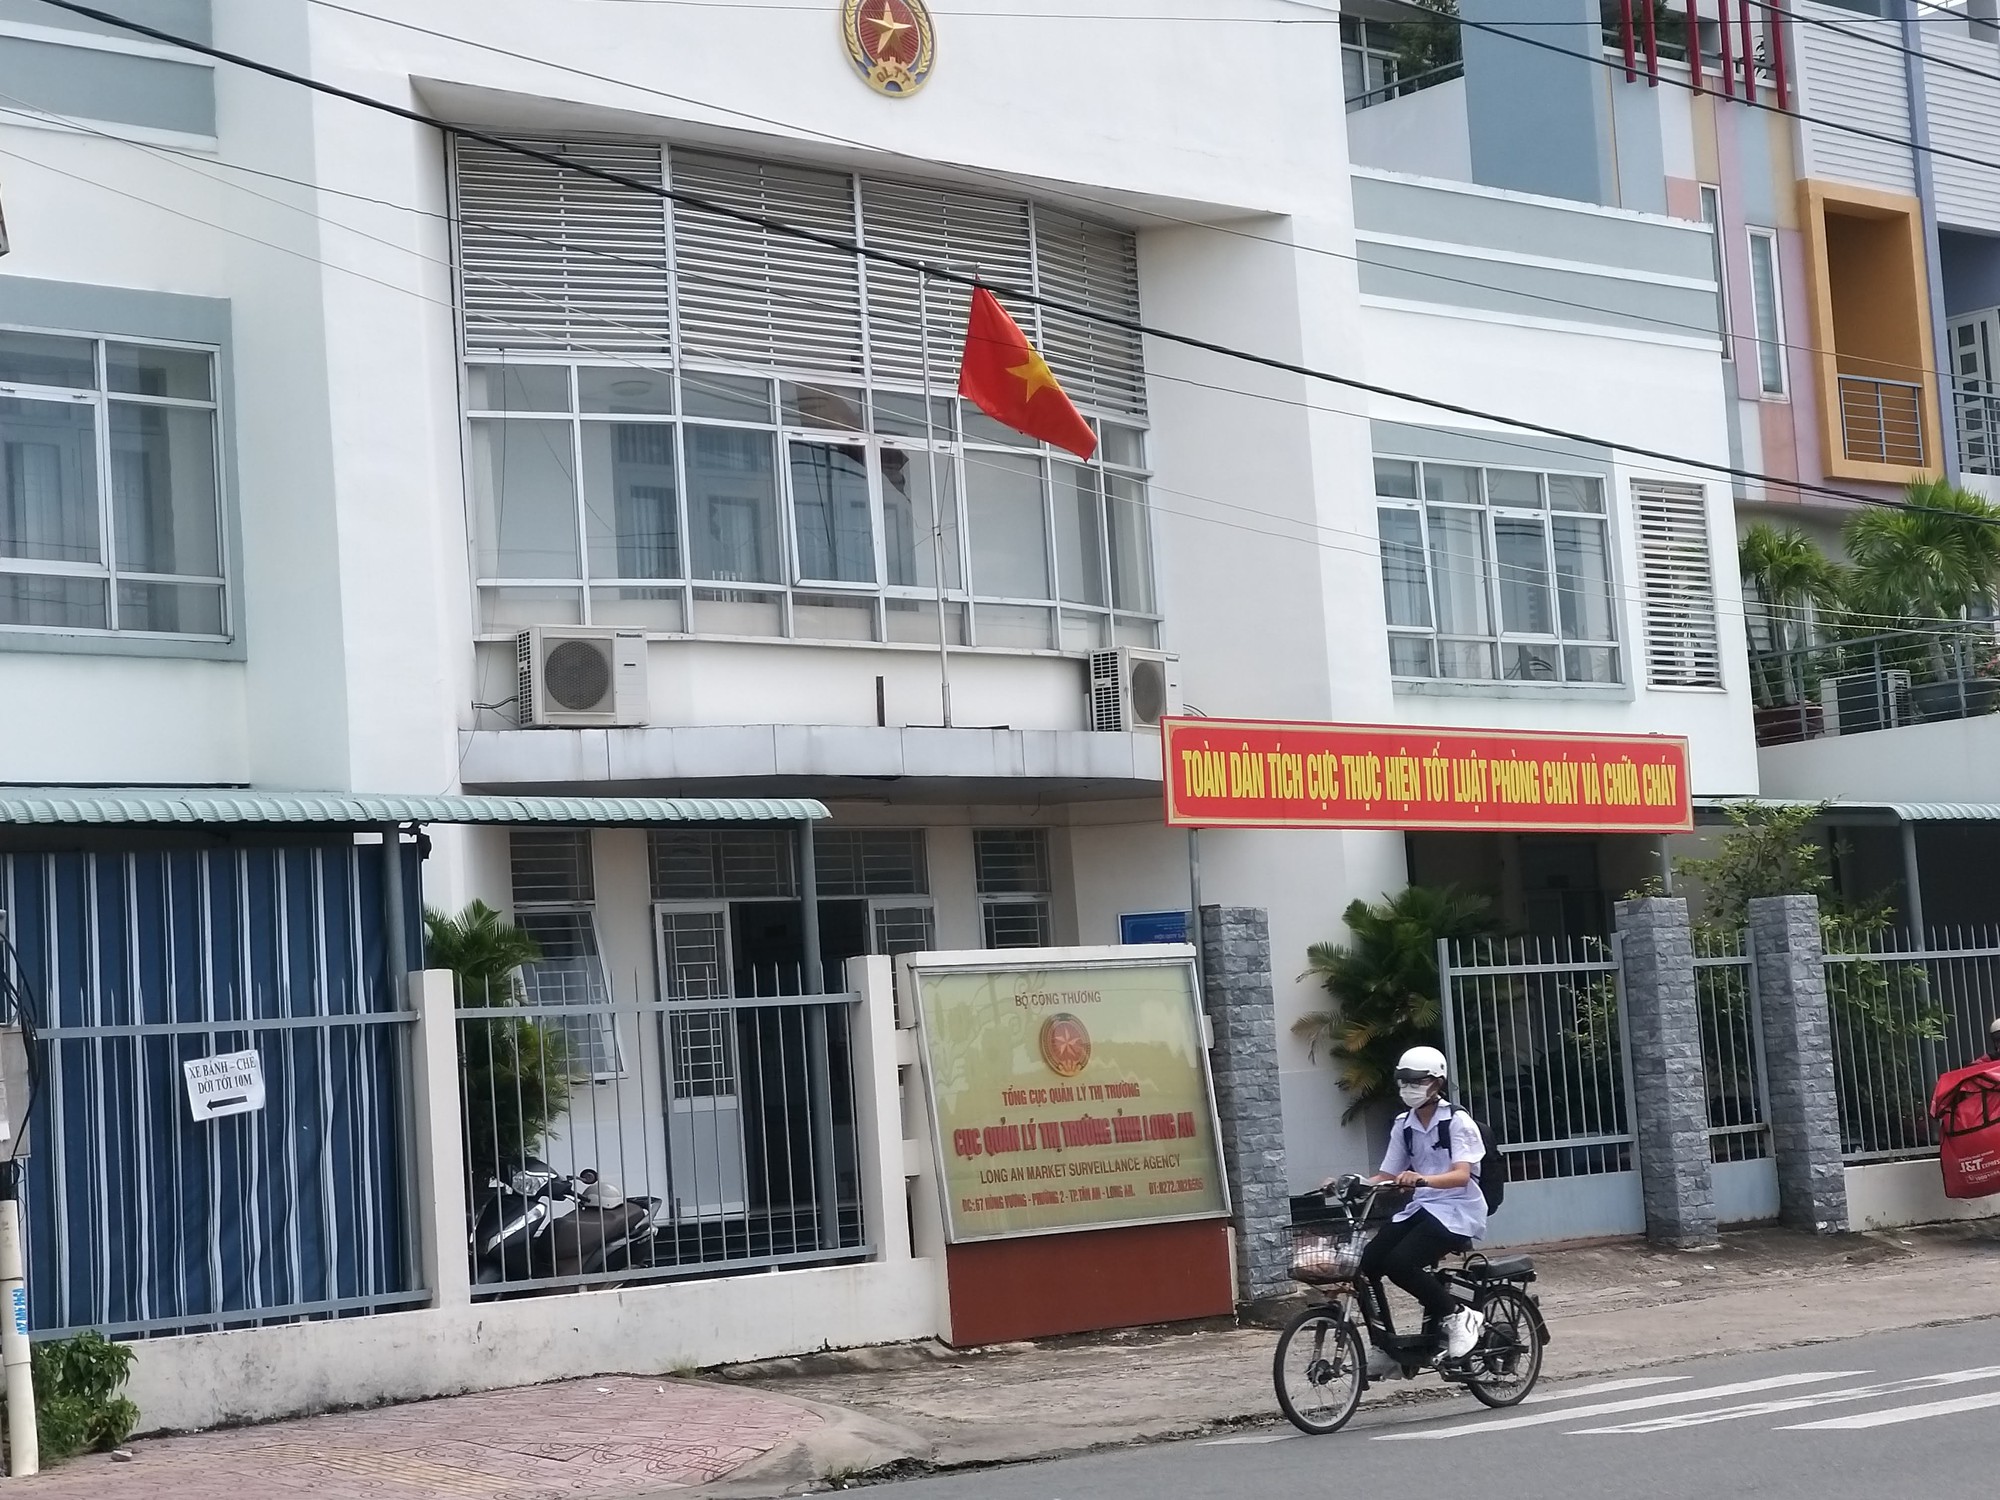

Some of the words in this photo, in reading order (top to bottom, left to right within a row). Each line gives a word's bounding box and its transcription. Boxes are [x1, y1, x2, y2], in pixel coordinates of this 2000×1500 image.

[1182, 740, 1227, 798] TOÀN
[1230, 742, 1265, 798] DÂN
[1267, 742, 1304, 799] TÍCH
[1307, 750, 1339, 810] CỰC
[1342, 750, 1382, 811] THỰC
[1384, 746, 1421, 812] HIỆN
[1423, 742, 1449, 802] TỐT
[1452, 749, 1487, 812] LUẬT
[1490, 749, 1540, 804] PHÒNG
[1542, 752, 1578, 805] CHÁY
[1581, 753, 1602, 805] VÀ
[1603, 754, 1640, 806] CHỮA
[1642, 755, 1676, 806] CHÁY
[1015, 992, 1028, 1009] BỘ
[1032, 991, 1060, 1006] CÔNG
[1061, 990, 1102, 1004] THƯƠNG
[189, 1065, 202, 1080] XE
[202, 1060, 228, 1076] BÁNH
[236, 1053, 256, 1070] CHÈ
[198, 1078, 214, 1094] DỜI
[216, 1074, 232, 1090] TỚI
[234, 1074, 252, 1088] 10M
[1002, 1084, 1028, 1106] TỔNG
[1029, 1088, 1048, 1108] CỤC
[1049, 1082, 1074, 1104] QUẢN
[1076, 1083, 1086, 1102] LÝ
[1088, 1085, 1104, 1102] THỊ
[1104, 1080, 1140, 1100] TRƯỜNG
[954, 1128, 982, 1160] CỤC
[984, 1117, 1021, 1156] QUẢN
[1021, 1118, 1037, 1151] LÝ
[1038, 1122, 1062, 1152] THỊ
[1060, 1113, 1112, 1148] TRƯỜNG
[1142, 1113, 1177, 1141] LONG
[1177, 1112, 1196, 1138] AN
[980, 1168, 1008, 1184] LONG
[1010, 1167, 1024, 1182] AN
[1026, 1164, 1066, 1180] MARKET
[1068, 1158, 1140, 1176] SURVEILLANCE
[1144, 1154, 1180, 1170] AGENCY
[1960, 1158, 1984, 1172] J&T
[1060, 1190, 1064, 1204] 2
